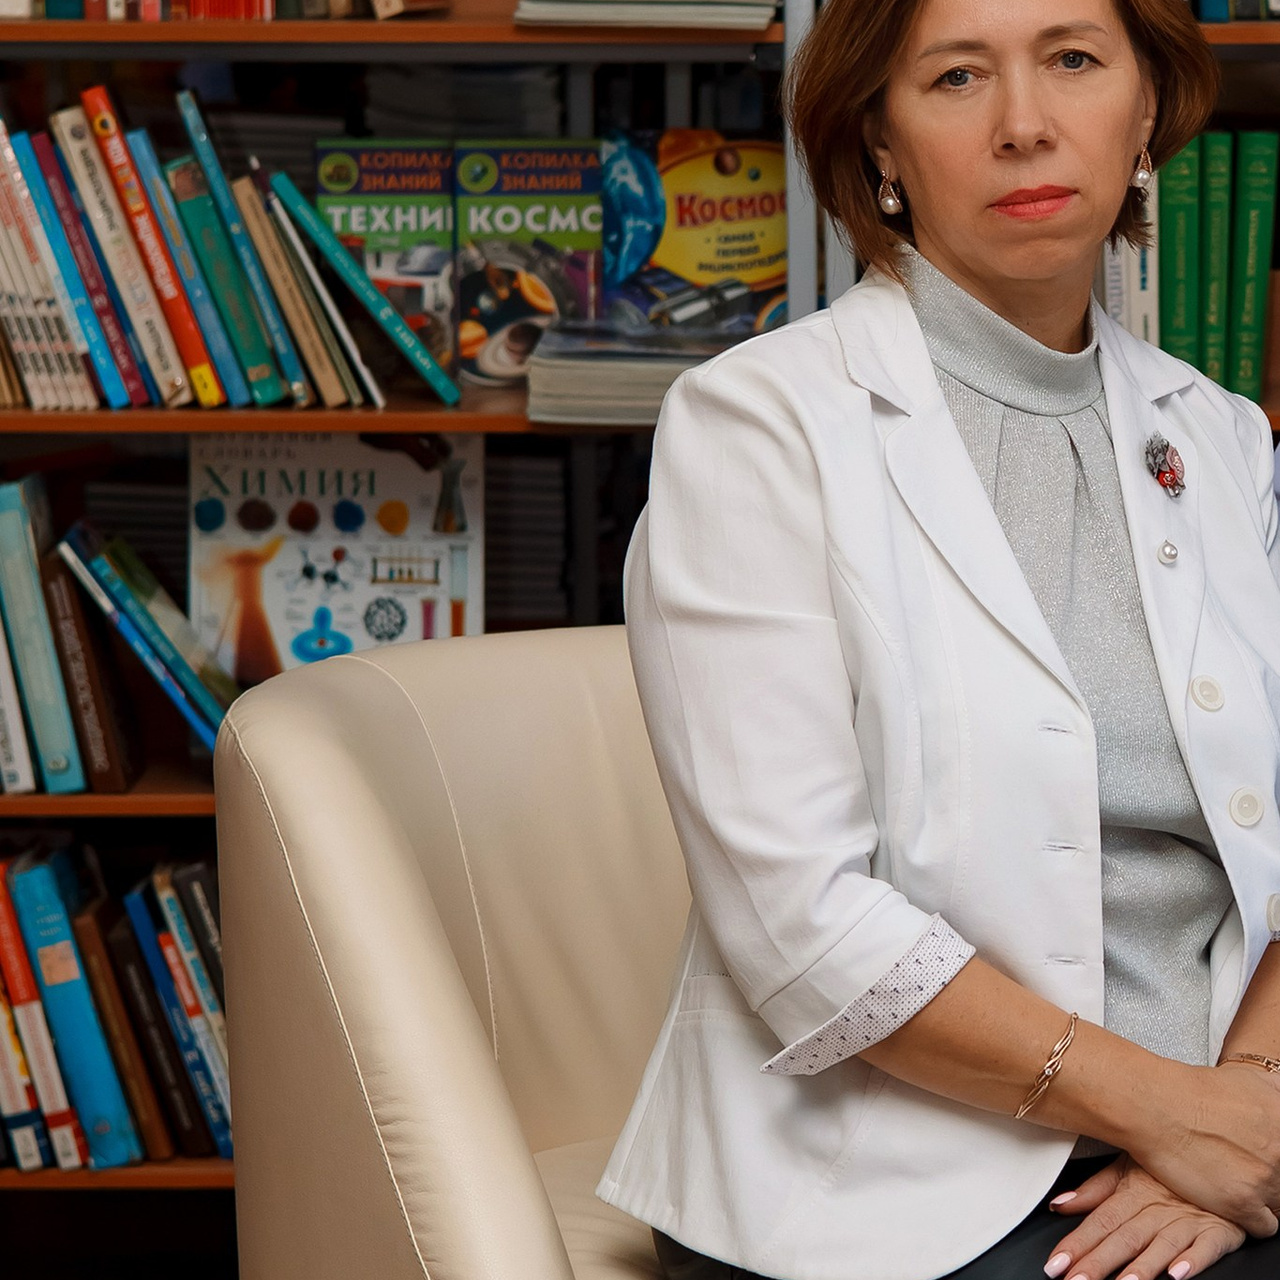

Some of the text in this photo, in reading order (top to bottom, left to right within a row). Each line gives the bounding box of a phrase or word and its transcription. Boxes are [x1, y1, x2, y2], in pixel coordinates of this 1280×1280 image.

[502, 153, 600, 168] КОПИЛКА
[362, 173, 442, 190] ЗНАНИЙ
[502, 173, 582, 190] ЗНАНИЙ
[202, 465, 377, 496] ХИМИЯ
